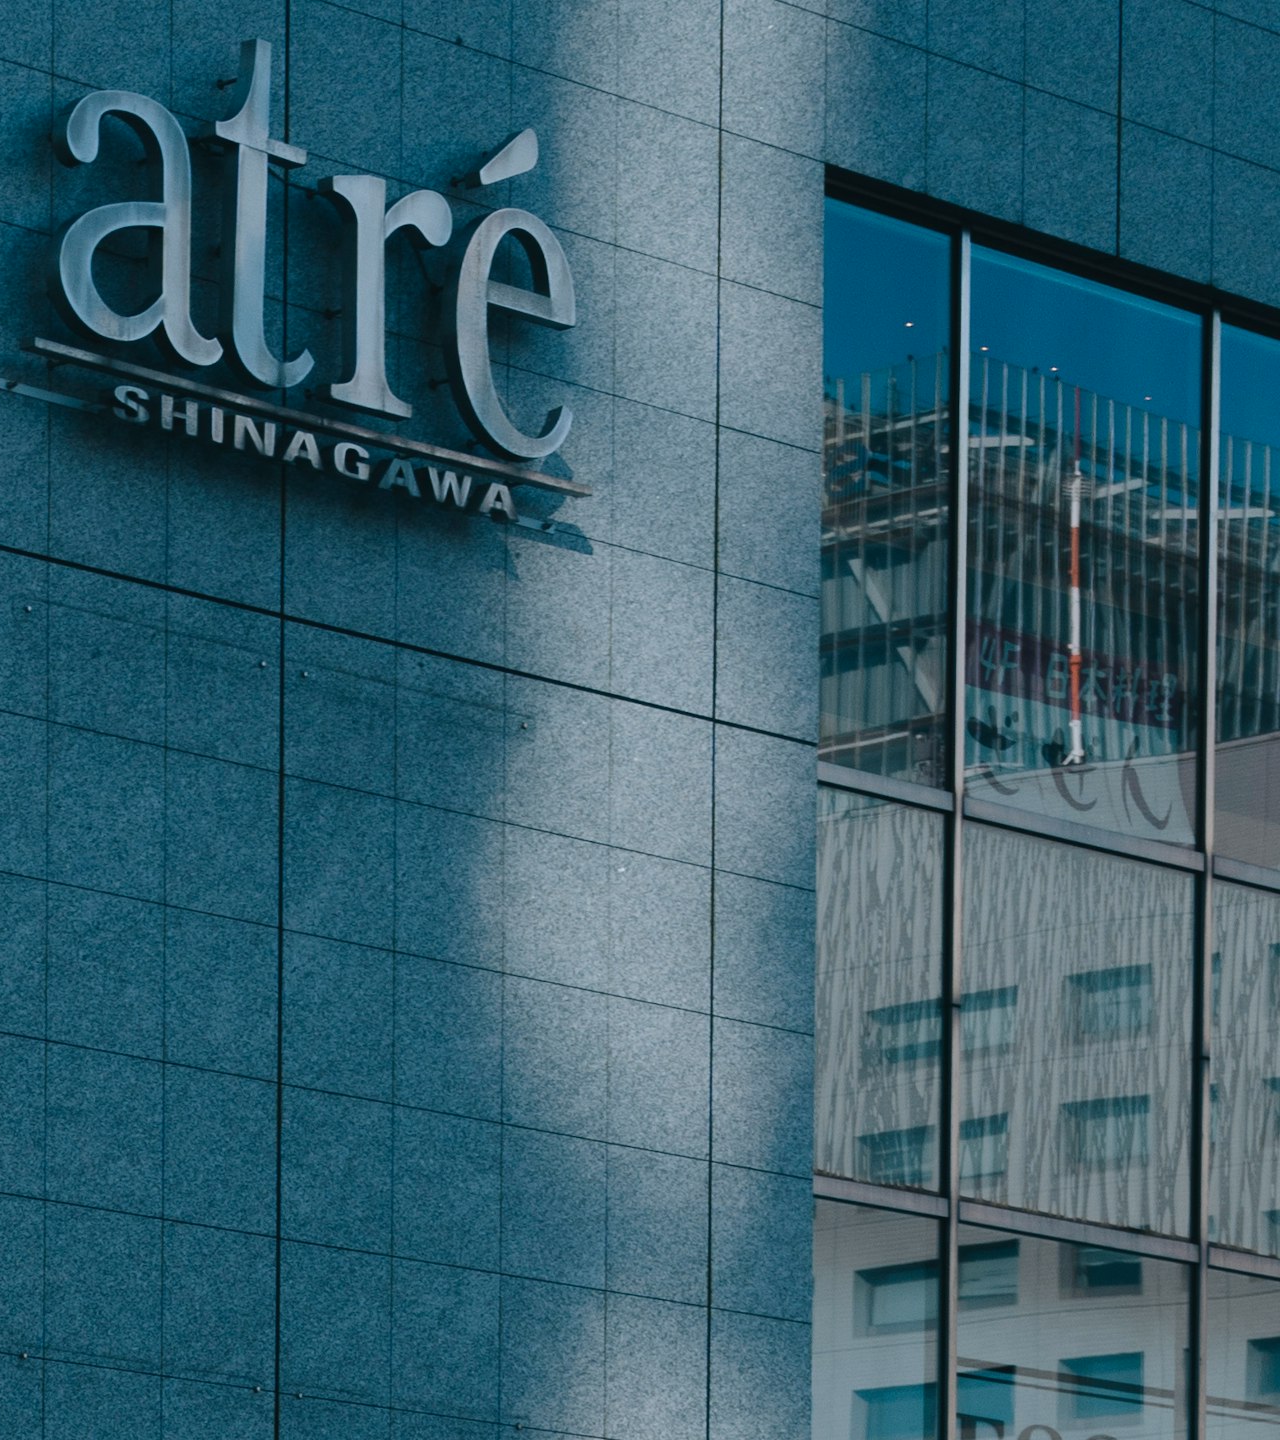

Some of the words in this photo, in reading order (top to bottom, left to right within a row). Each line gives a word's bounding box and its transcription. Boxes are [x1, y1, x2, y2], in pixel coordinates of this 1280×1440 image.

[54, 38, 577, 461] atré
[112, 384, 520, 522] SHINAGAWA
[979, 637, 1021, 685] 4F
[1045, 652, 1179, 721] 日本料理
